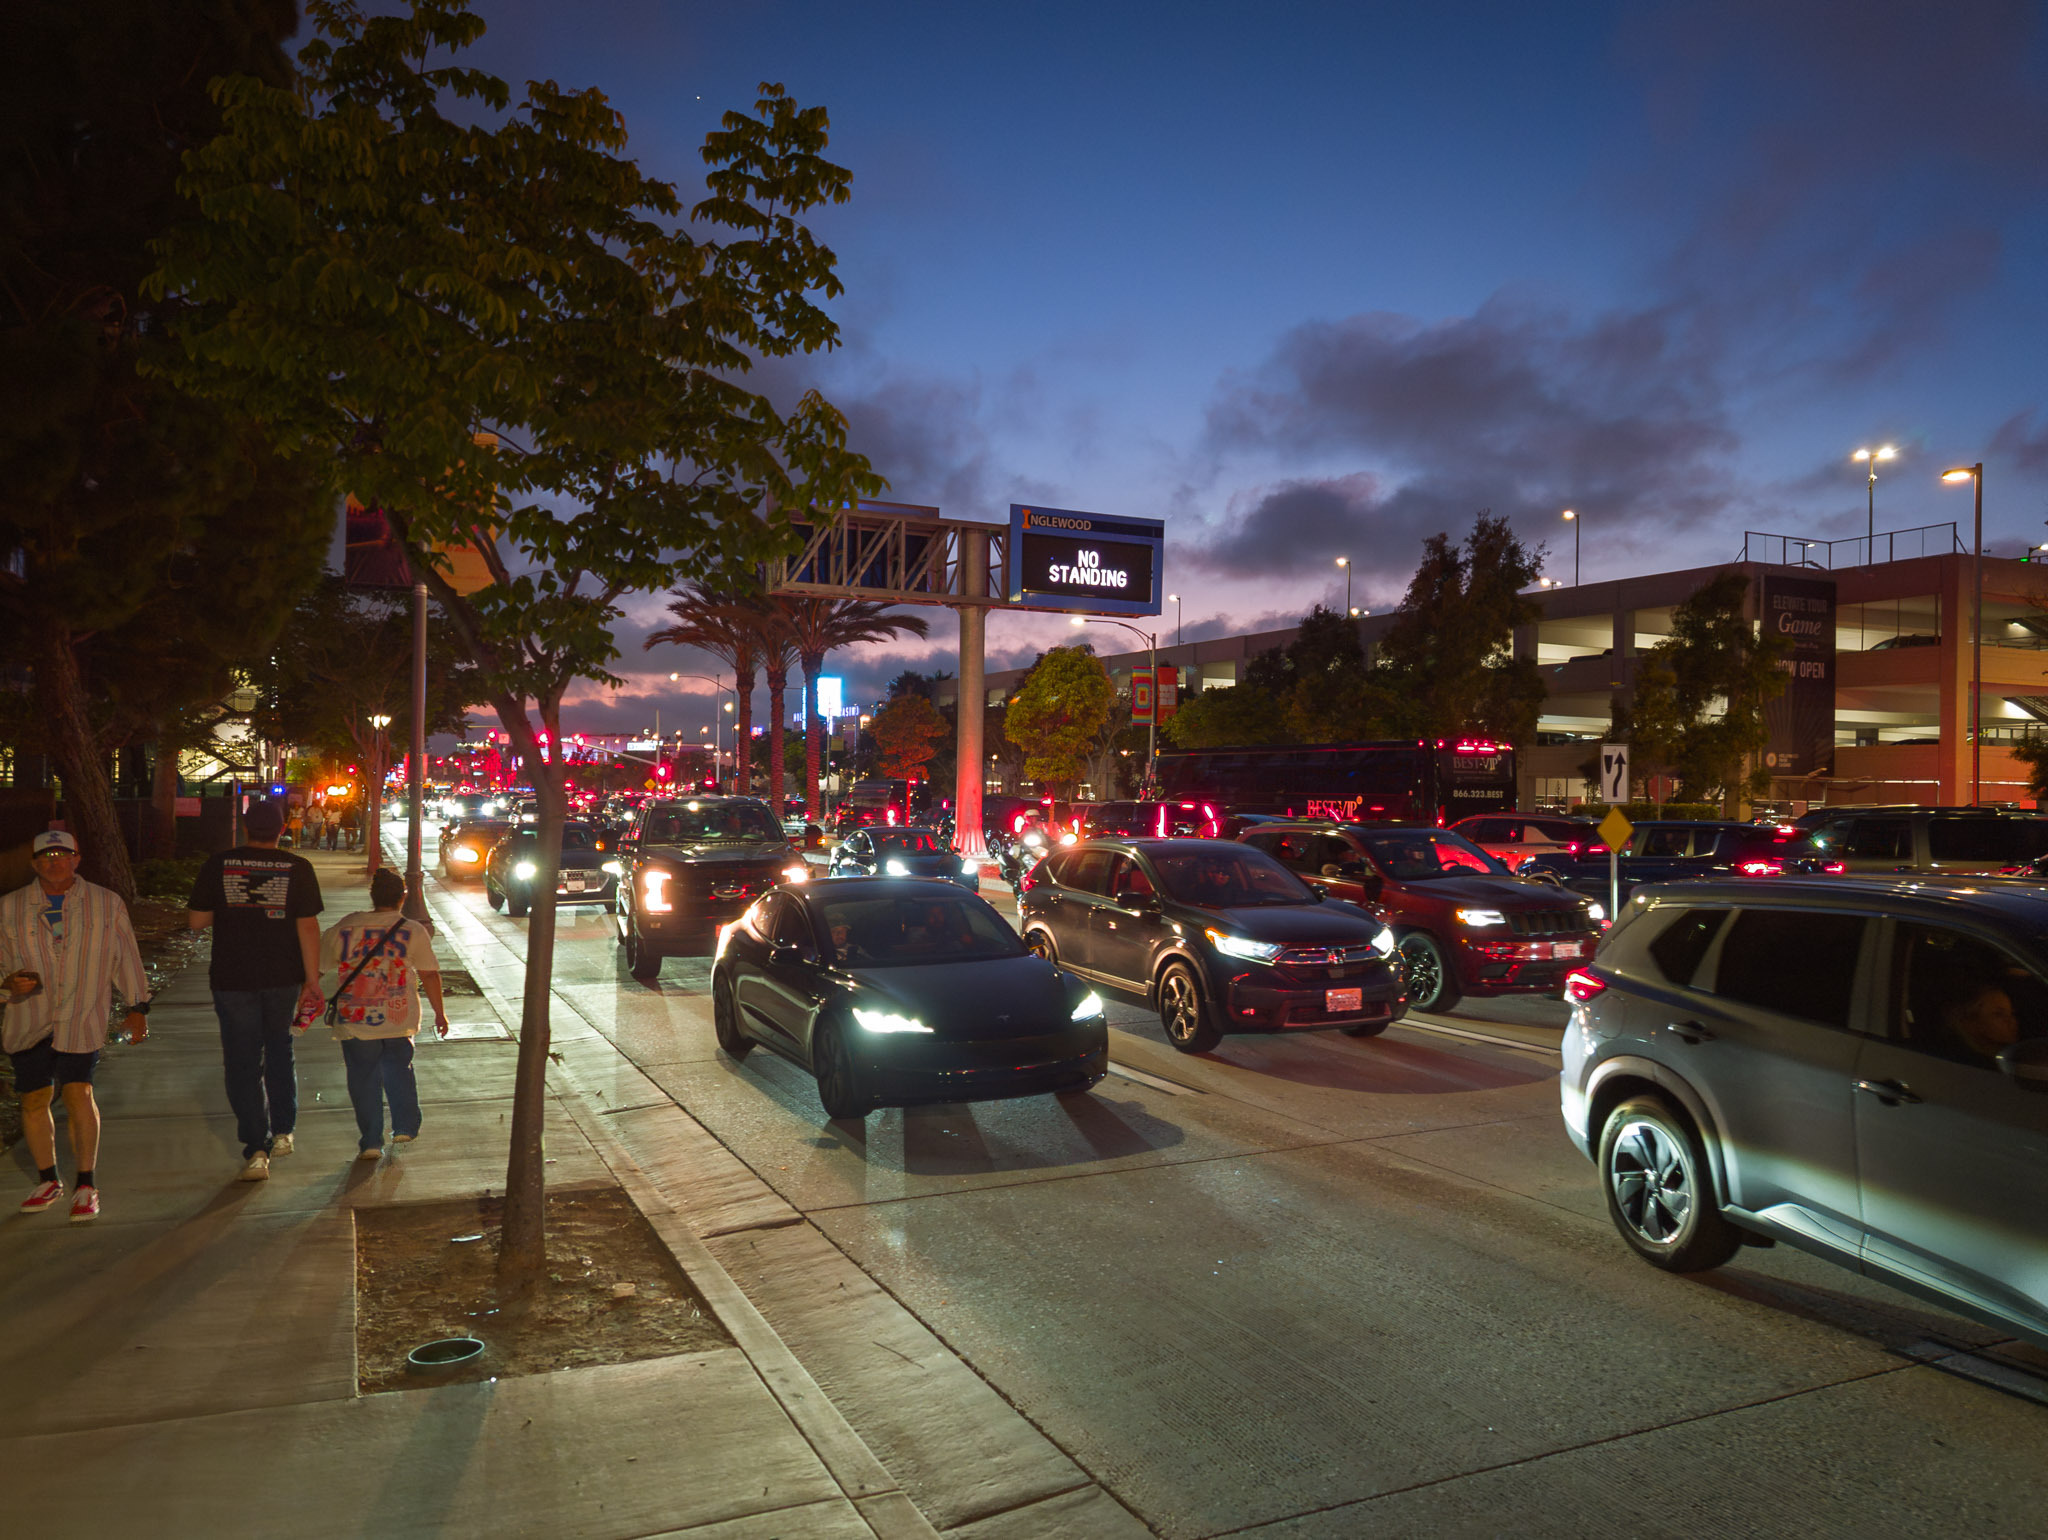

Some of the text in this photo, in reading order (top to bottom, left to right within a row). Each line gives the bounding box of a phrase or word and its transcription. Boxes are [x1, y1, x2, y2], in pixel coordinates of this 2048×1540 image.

[1022, 509, 1092, 531] INGLEWOOD
[1078, 550, 1099, 568] NO
[1049, 565, 1127, 588] STANDING
[1779, 612, 1821, 635] Game
[1800, 661, 1825, 679] OPEN
[1453, 789, 1504, 799] 866.323.BEST
[243, 860, 274, 868] WORLD
